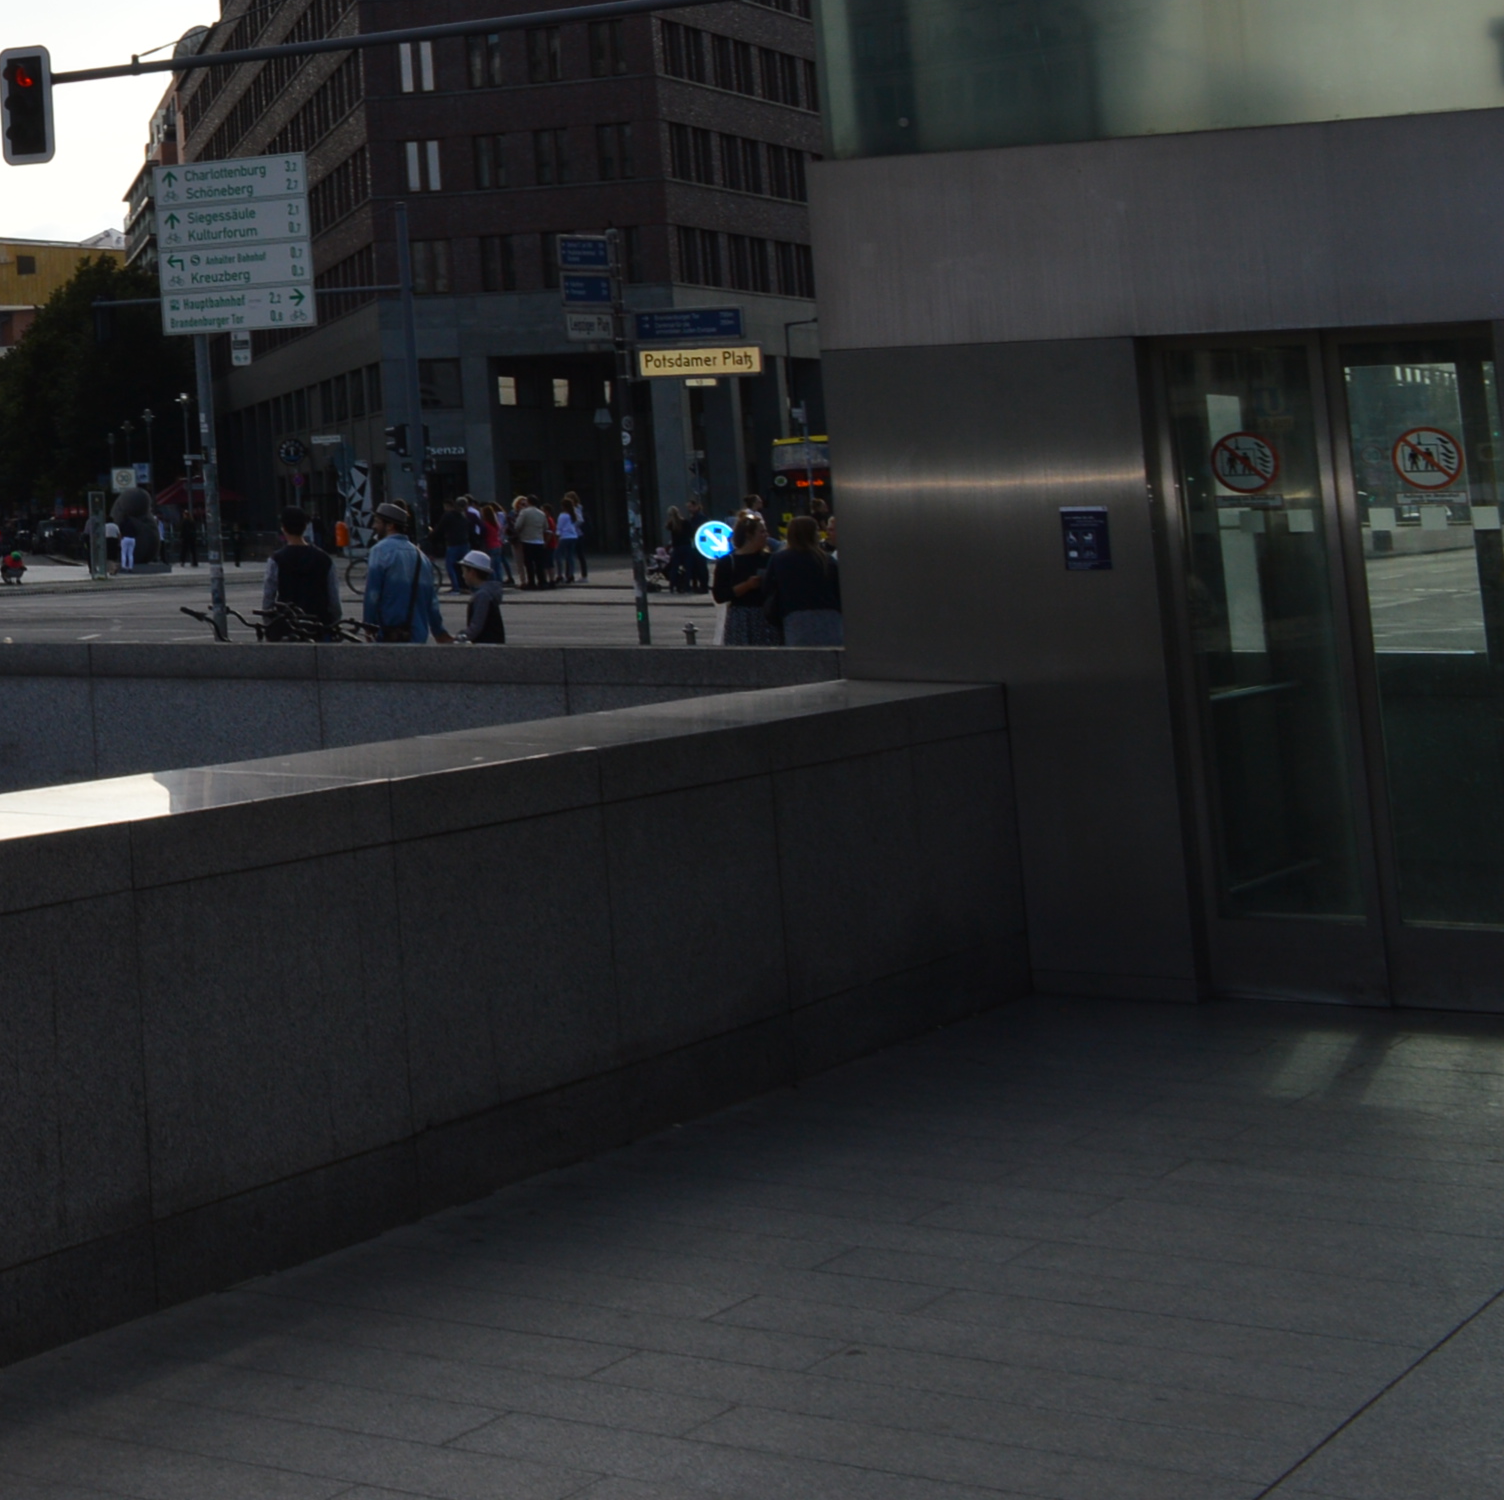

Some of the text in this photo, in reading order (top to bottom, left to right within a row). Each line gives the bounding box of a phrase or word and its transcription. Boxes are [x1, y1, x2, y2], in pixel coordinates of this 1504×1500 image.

[184, 164, 266, 182] Charlottenburg
[186, 184, 254, 200] Schöneberg
[187, 207, 256, 226] Siegessäule
[188, 226, 258, 242] Kulturforum
[237, 252, 266, 264] Bahnhof
[191, 270, 251, 284] Kreuzberg
[184, 295, 245, 312] Hauptbahnhof
[170, 315, 230, 329] Brandenburger
[232, 313, 244, 324] Tor
[644, 350, 753, 369] Potsdamer Platz
